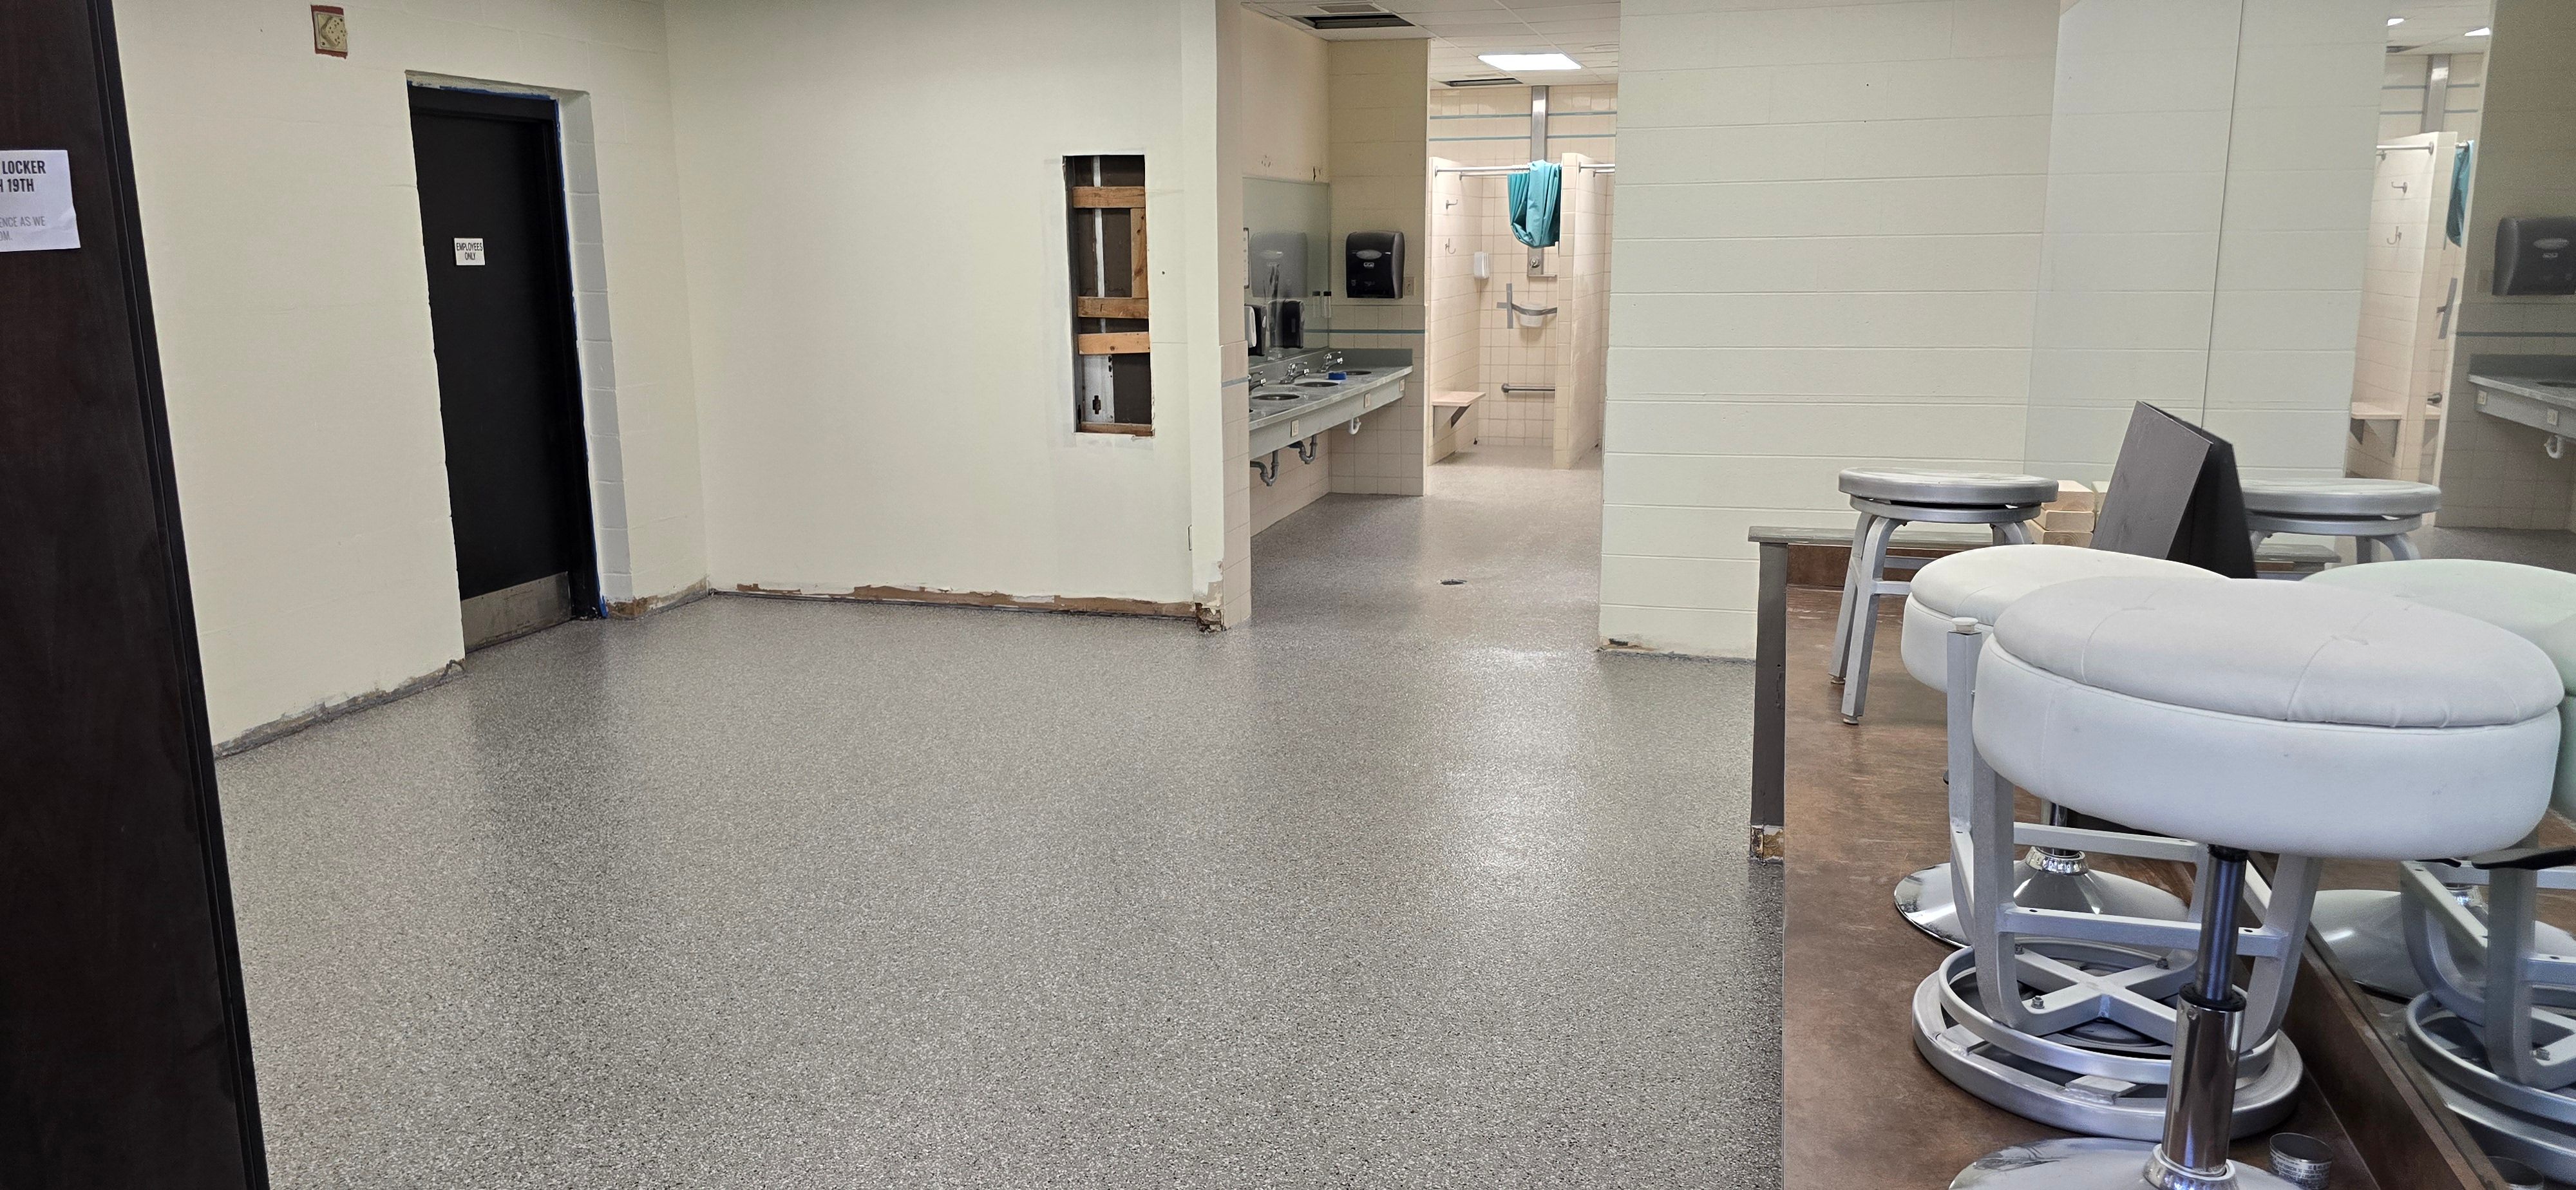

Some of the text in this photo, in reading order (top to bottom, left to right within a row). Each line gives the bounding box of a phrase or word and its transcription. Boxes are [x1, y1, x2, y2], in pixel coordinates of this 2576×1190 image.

[3, 160, 46, 175] LOCKER
[7, 178, 34, 193] 19TH
[20, 216, 32, 227] AS
[32, 216, 46, 226] WE
[457, 242, 483, 251] EMPLOYEES
[464, 252, 476, 260] ONLY
